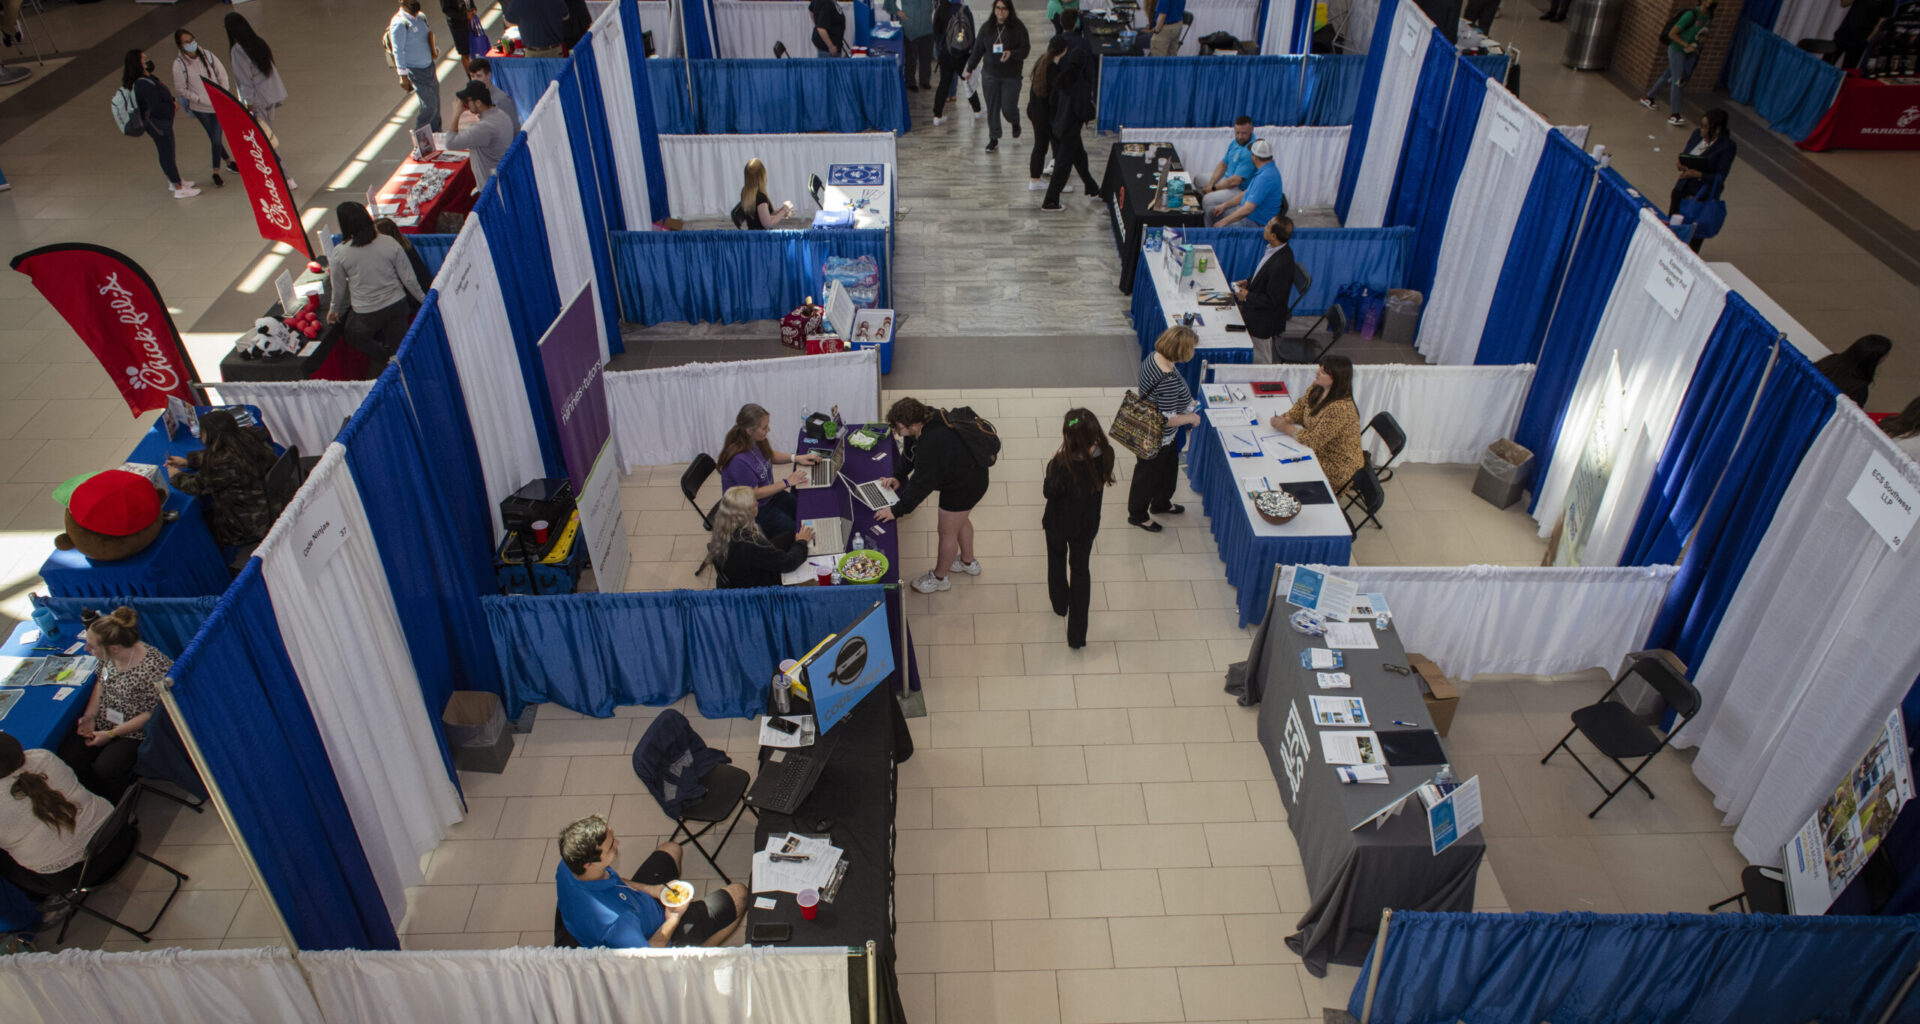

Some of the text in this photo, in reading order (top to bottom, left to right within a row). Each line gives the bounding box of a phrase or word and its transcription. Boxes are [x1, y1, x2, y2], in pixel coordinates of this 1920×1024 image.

[1860, 127, 1920, 135] MARINES.
[243, 128, 292, 230] Chick-fil-A
[100, 272, 179, 391] Chick-fil-A
[1872, 468, 1884, 484] ECS
[1881, 493, 1893, 505] LLP
[304, 521, 330, 558] Code Ninjas
[340, 527, 347, 537] 37
[1893, 536, 1900, 546] 50
[824, 690, 851, 721] CODE
[1281, 706, 1309, 798] ECS
